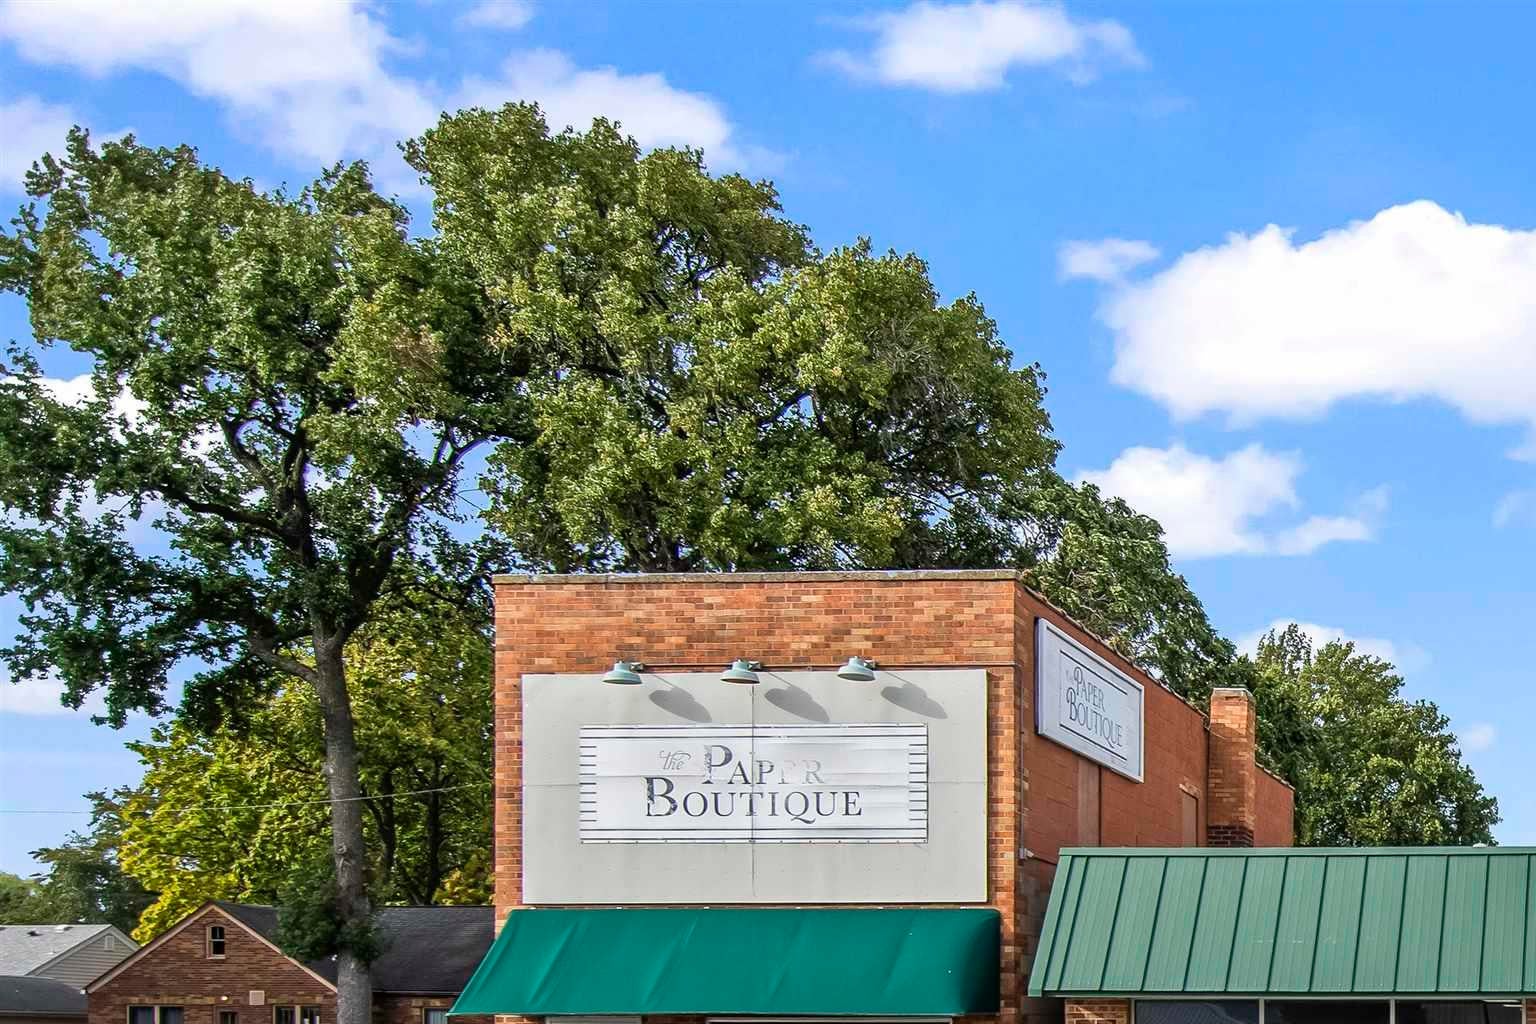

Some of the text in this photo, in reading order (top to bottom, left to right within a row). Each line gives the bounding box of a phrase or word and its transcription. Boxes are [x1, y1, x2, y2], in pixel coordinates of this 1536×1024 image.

[1073, 666, 1105, 712] PAPER
[1066, 687, 1123, 749] BOUTIQUE
[644, 776, 863, 825] BOUTIQUE
